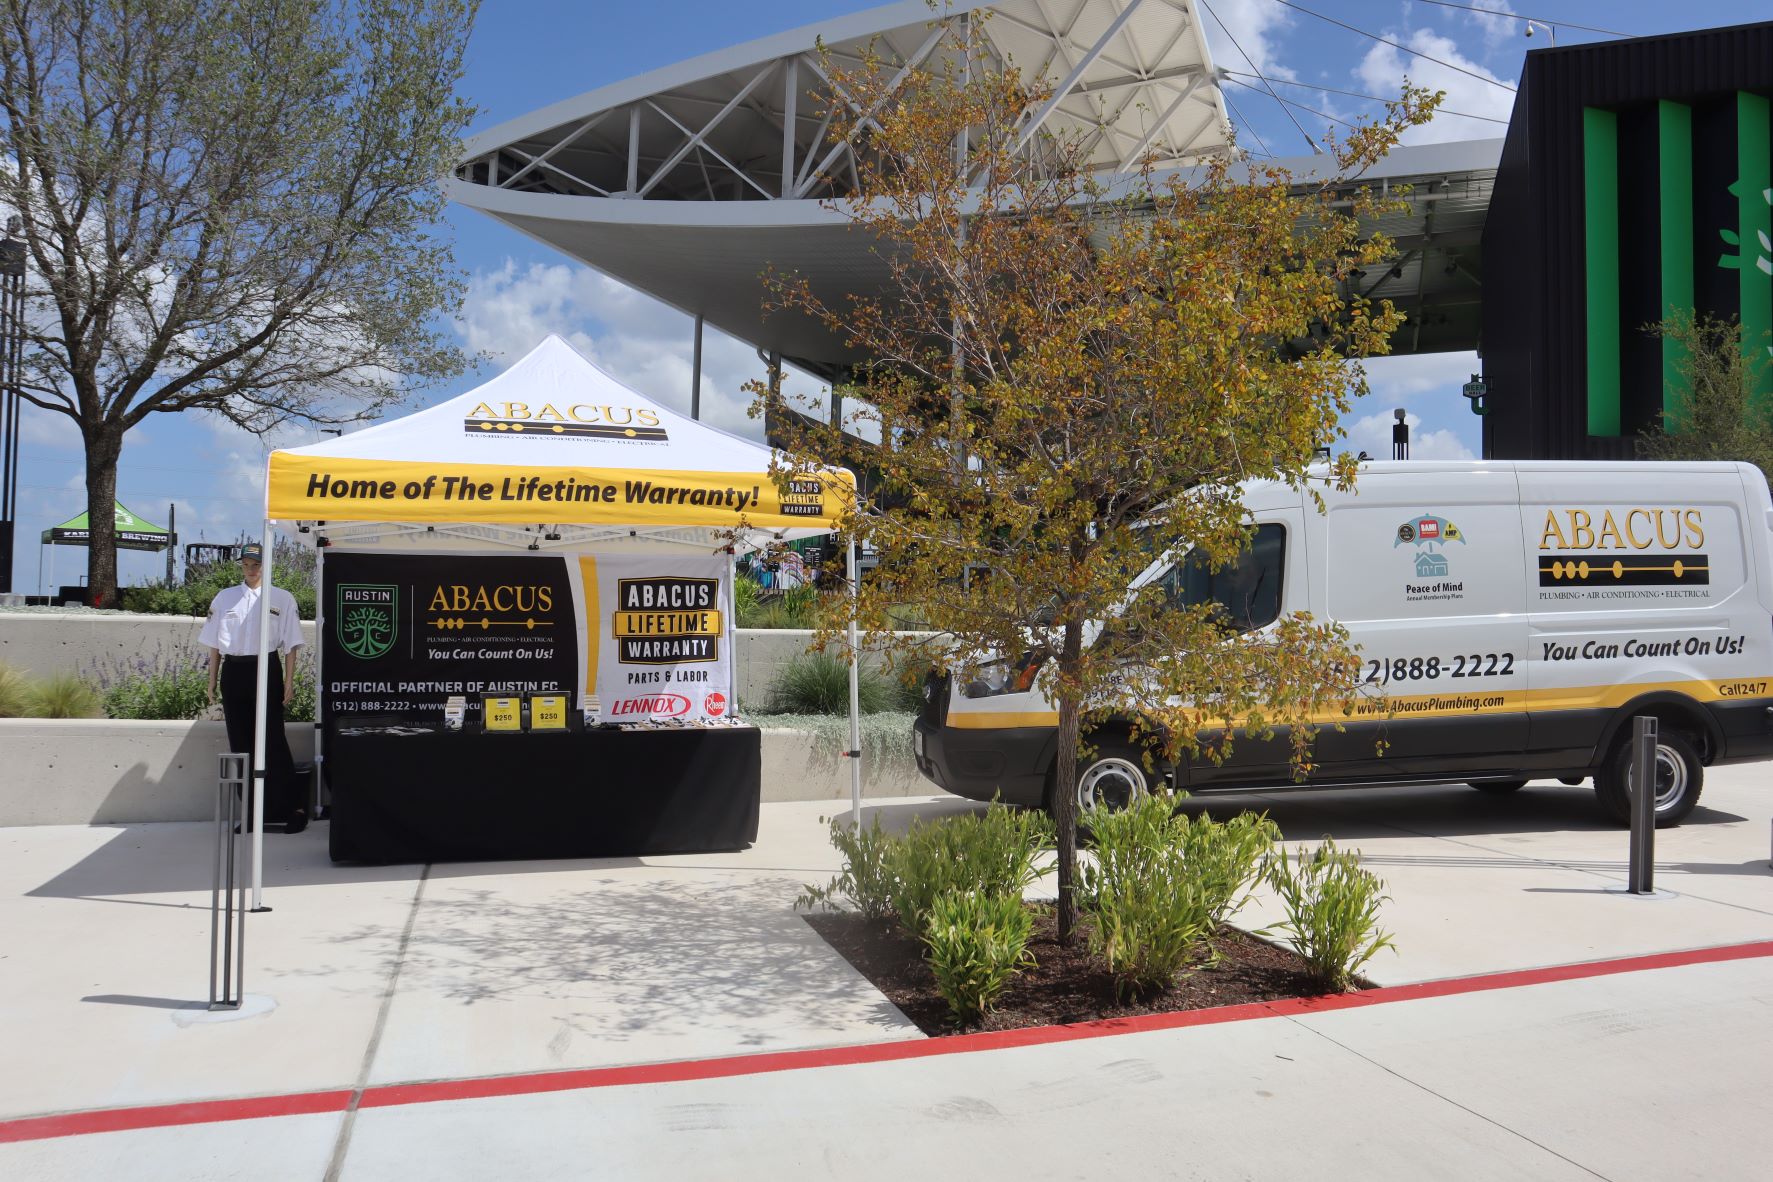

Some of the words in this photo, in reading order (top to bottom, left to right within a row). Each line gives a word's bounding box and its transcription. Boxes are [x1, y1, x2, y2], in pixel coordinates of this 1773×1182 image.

[465, 401, 660, 426] ABACUS
[306, 473, 397, 499] Home
[403, 475, 437, 500] of
[442, 476, 494, 501] The
[500, 475, 617, 502] Lifetime
[624, 480, 760, 512] Warranty!
[785, 482, 820, 493] BACUS
[784, 495, 819, 503] LIFETIME
[783, 505, 820, 514] WARRANTY
[1538, 508, 1705, 550] ABACUS
[121, 532, 168, 542] BREWING
[1406, 584, 1430, 594] Peace
[1432, 583, 1441, 592] of
[1442, 582, 1463, 592] Mind
[345, 590, 390, 601] AUSTIN
[428, 585, 553, 612] ABACUS
[627, 584, 709, 608] ABACUS
[1539, 592, 1581, 600] PLUMBING
[1587, 591, 1600, 599] AIR
[1601, 591, 1660, 599] CONDITIONING
[1665, 590, 1711, 598] ELECTRICAL
[627, 613, 709, 633] LIFETIME
[375, 632, 381, 640] C
[428, 648, 450, 660] You
[452, 648, 475, 660] Can
[478, 648, 513, 660] Count
[515, 648, 533, 660] On
[535, 648, 554, 660] Us!
[628, 639, 708, 658] WARRANTY
[1543, 642, 1578, 661] You
[1582, 640, 1618, 660] Can
[1623, 639, 1682, 658] Count
[1684, 637, 1711, 656] On
[1715, 635, 1745, 654] Us!
[628, 671, 660, 684] PARTS
[665, 671, 672, 682] &
[676, 670, 708, 682] LABOR
[331, 681, 394, 693] OFFICIAL
[398, 681, 463, 693] PARTNER
[466, 681, 485, 693] OF
[487, 681, 538, 692] AUSTIN
[542, 681, 558, 691] FC
[1718, 682, 1767, 697] Call24/7
[331, 701, 358, 712] (512)
[360, 701, 410, 711] 888-2222
[611, 697, 676, 716] LENNOX
[706, 693, 725, 713] Rheem
[493, 714, 513, 722] $250
[539, 712, 558, 720] $250
